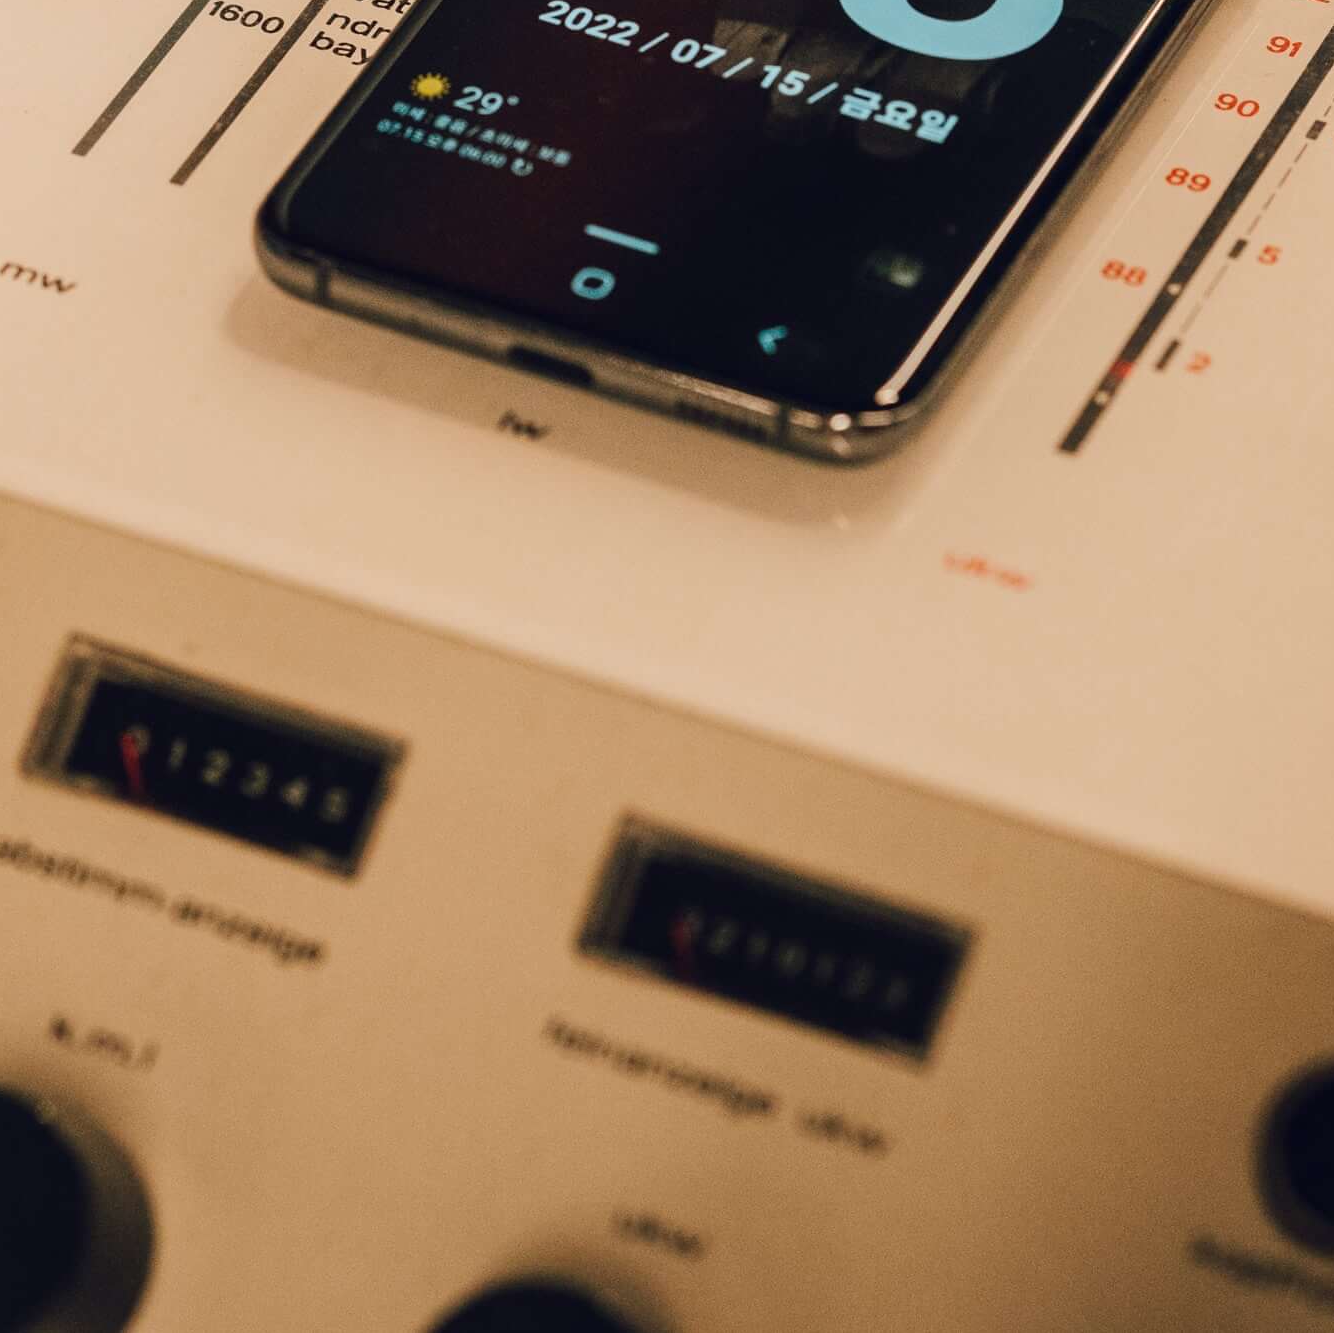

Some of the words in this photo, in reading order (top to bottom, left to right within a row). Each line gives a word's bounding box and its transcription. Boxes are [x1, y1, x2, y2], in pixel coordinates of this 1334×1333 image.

[209, 0, 286, 36] 1600
[1266, 34, 1303, 59] 91
[538, 0, 640, 49] 2022
[669, 37, 727, 72] 07
[758, 62, 810, 98] 15
[838, 87, 959, 146] 금요일
[1214, 92, 1260, 119] 90
[1165, 166, 1212, 193] 89
[1257, 244, 1283, 267] 5
[1100, 259, 1148, 288] 88
